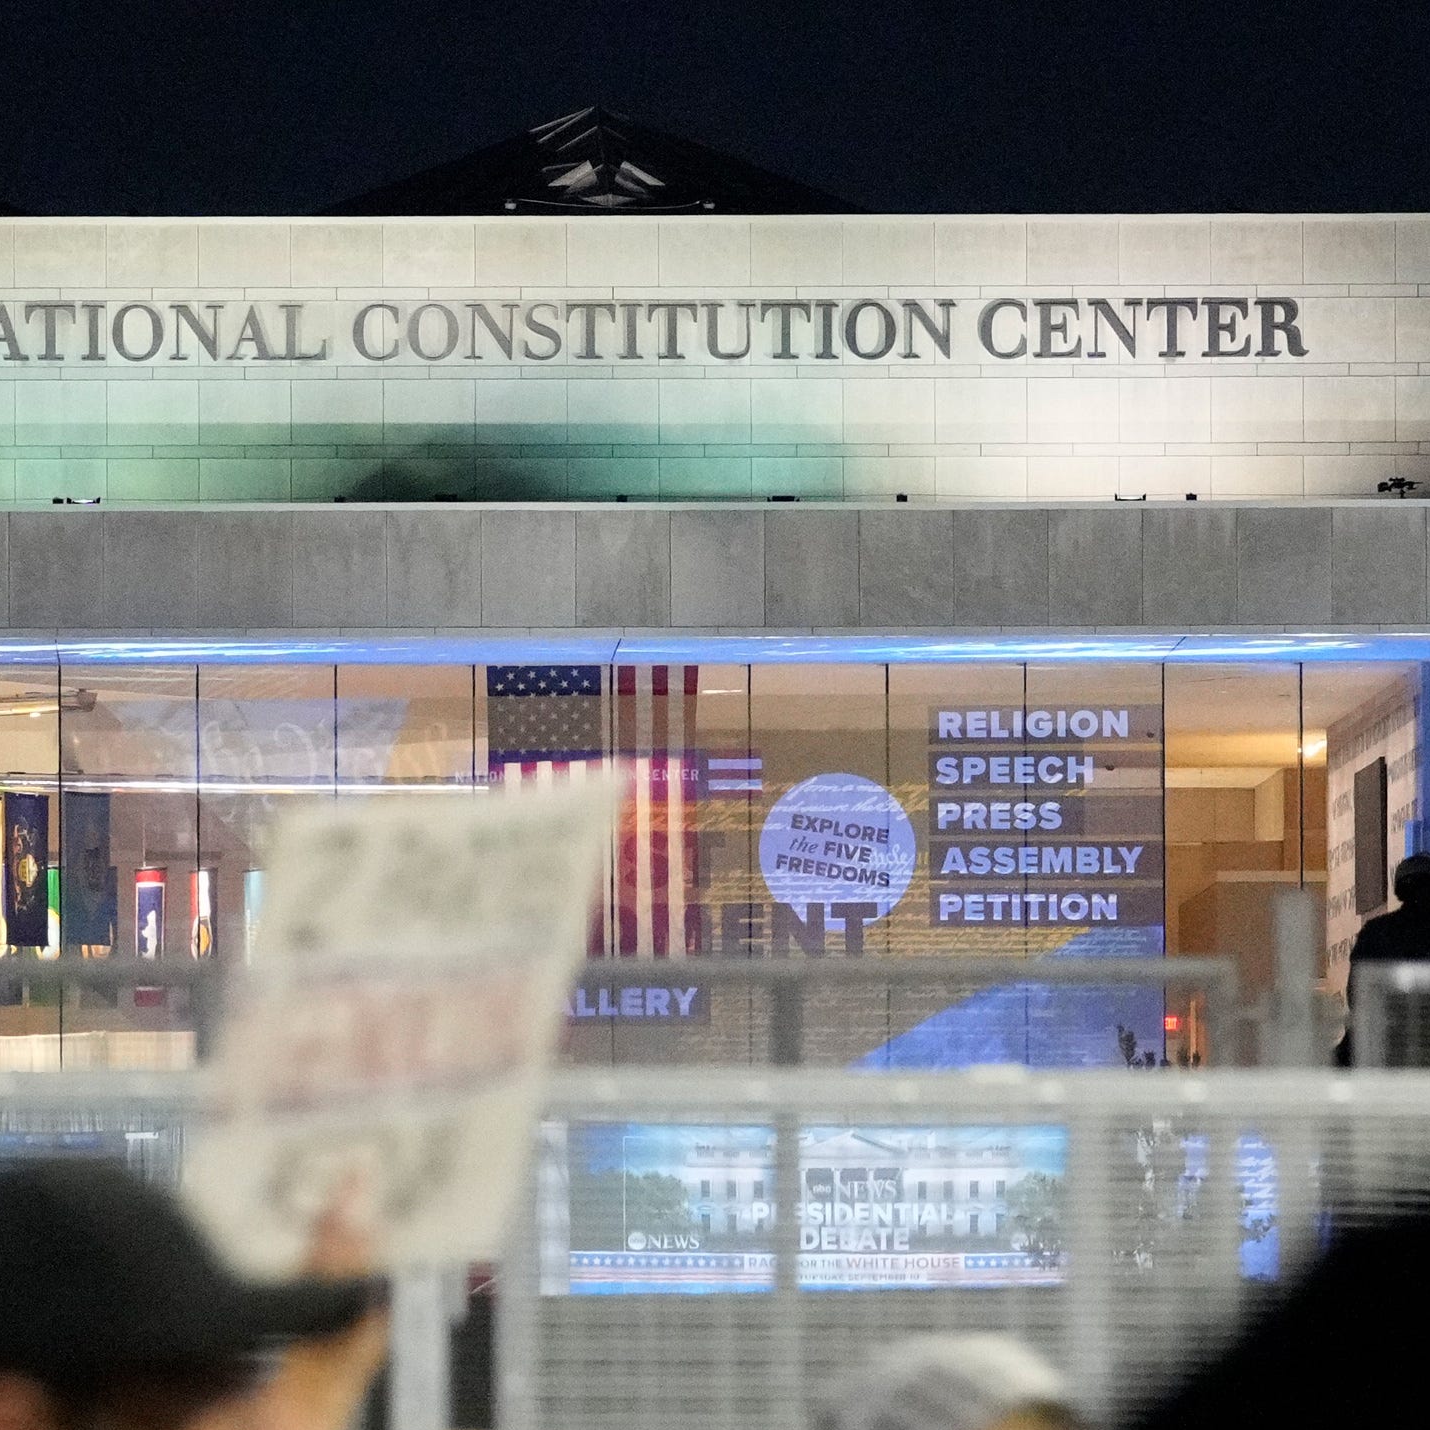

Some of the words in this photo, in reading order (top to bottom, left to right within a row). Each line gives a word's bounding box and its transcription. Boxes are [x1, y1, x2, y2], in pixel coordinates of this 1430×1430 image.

[352, 300, 956, 361] CONSTITUTION
[978, 298, 1309, 359] CENTER
[938, 710, 1128, 738] RELIGION
[936, 756, 1095, 784] SPEECH
[791, 814, 890, 845] EXPLORE
[938, 802, 1063, 830] PRESS
[789, 836, 819, 854] the
[824, 841, 872, 863] FIVE
[941, 846, 1144, 875] ASSEMBLY
[776, 854, 890, 888] FREEDOMS
[938, 894, 1118, 922] PETITION
[564, 987, 698, 1017] LLERY
[753, 1202, 952, 1226] PESIDENTIAL
[647, 1233, 700, 1249] NEWS
[800, 1227, 909, 1250] DEBATE
[846, 1257, 899, 1269] WHITE
[904, 1256, 960, 1269] HOUSE
